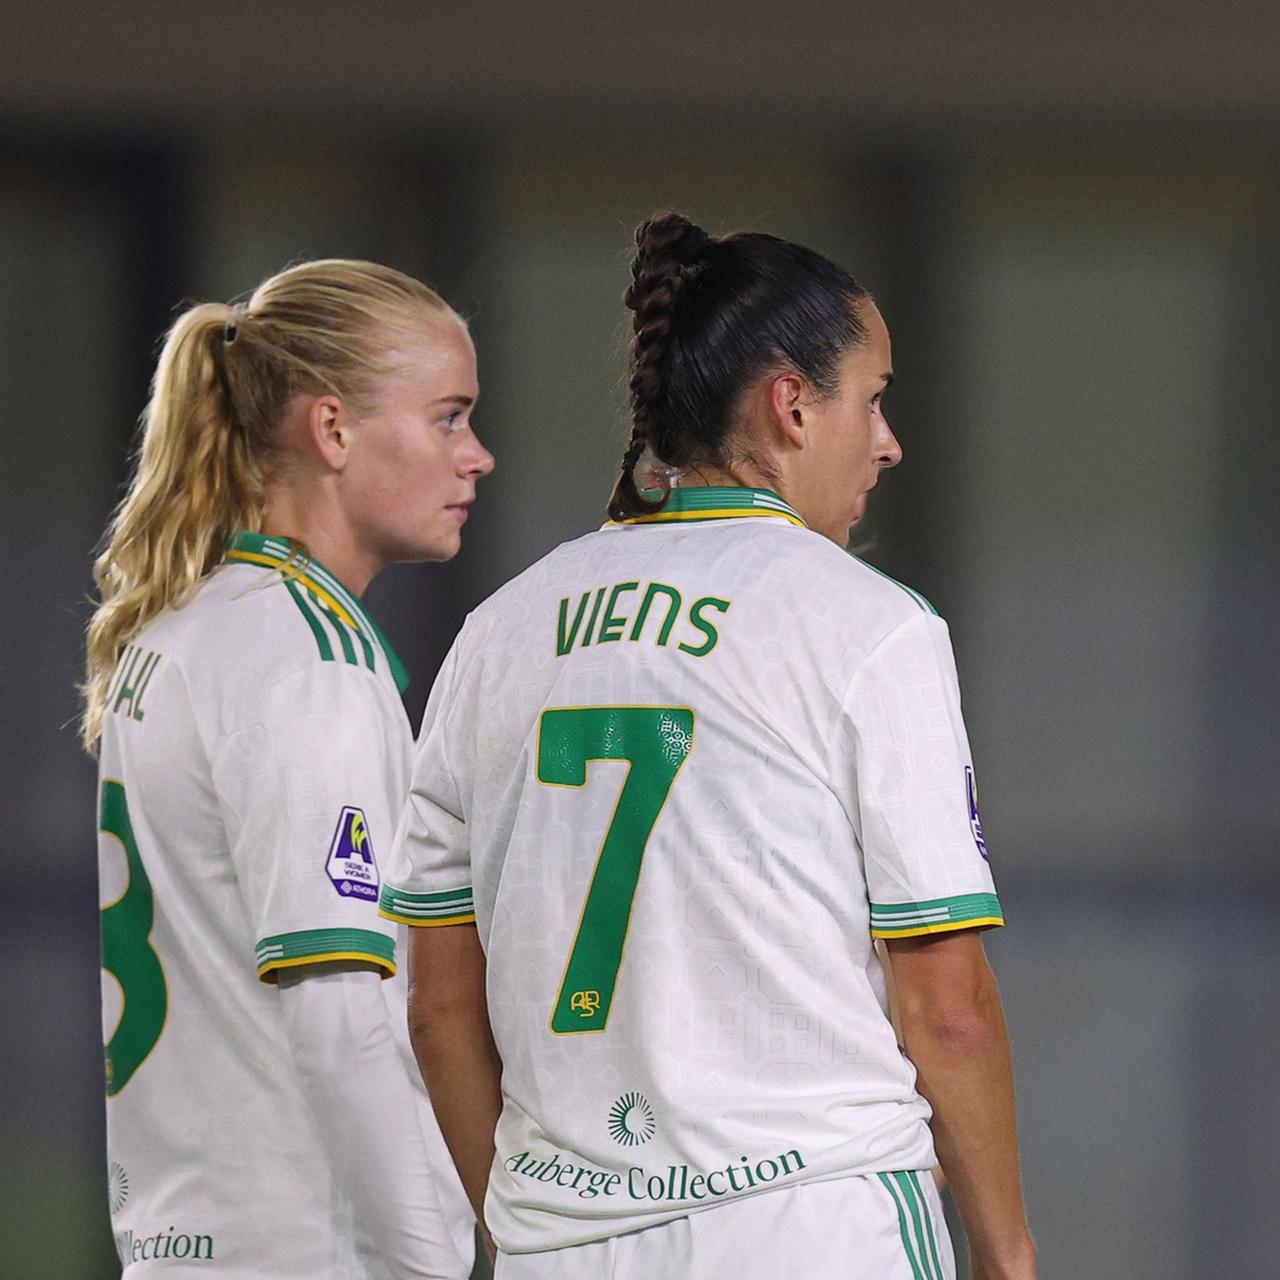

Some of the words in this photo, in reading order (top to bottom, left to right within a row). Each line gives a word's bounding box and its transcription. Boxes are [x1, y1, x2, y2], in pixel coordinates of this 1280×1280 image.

[557, 581, 732, 657] VIENS
[535, 704, 696, 1037] 7
[504, 1151, 621, 1199] Auberge
[628, 1149, 807, 1201] Collection
